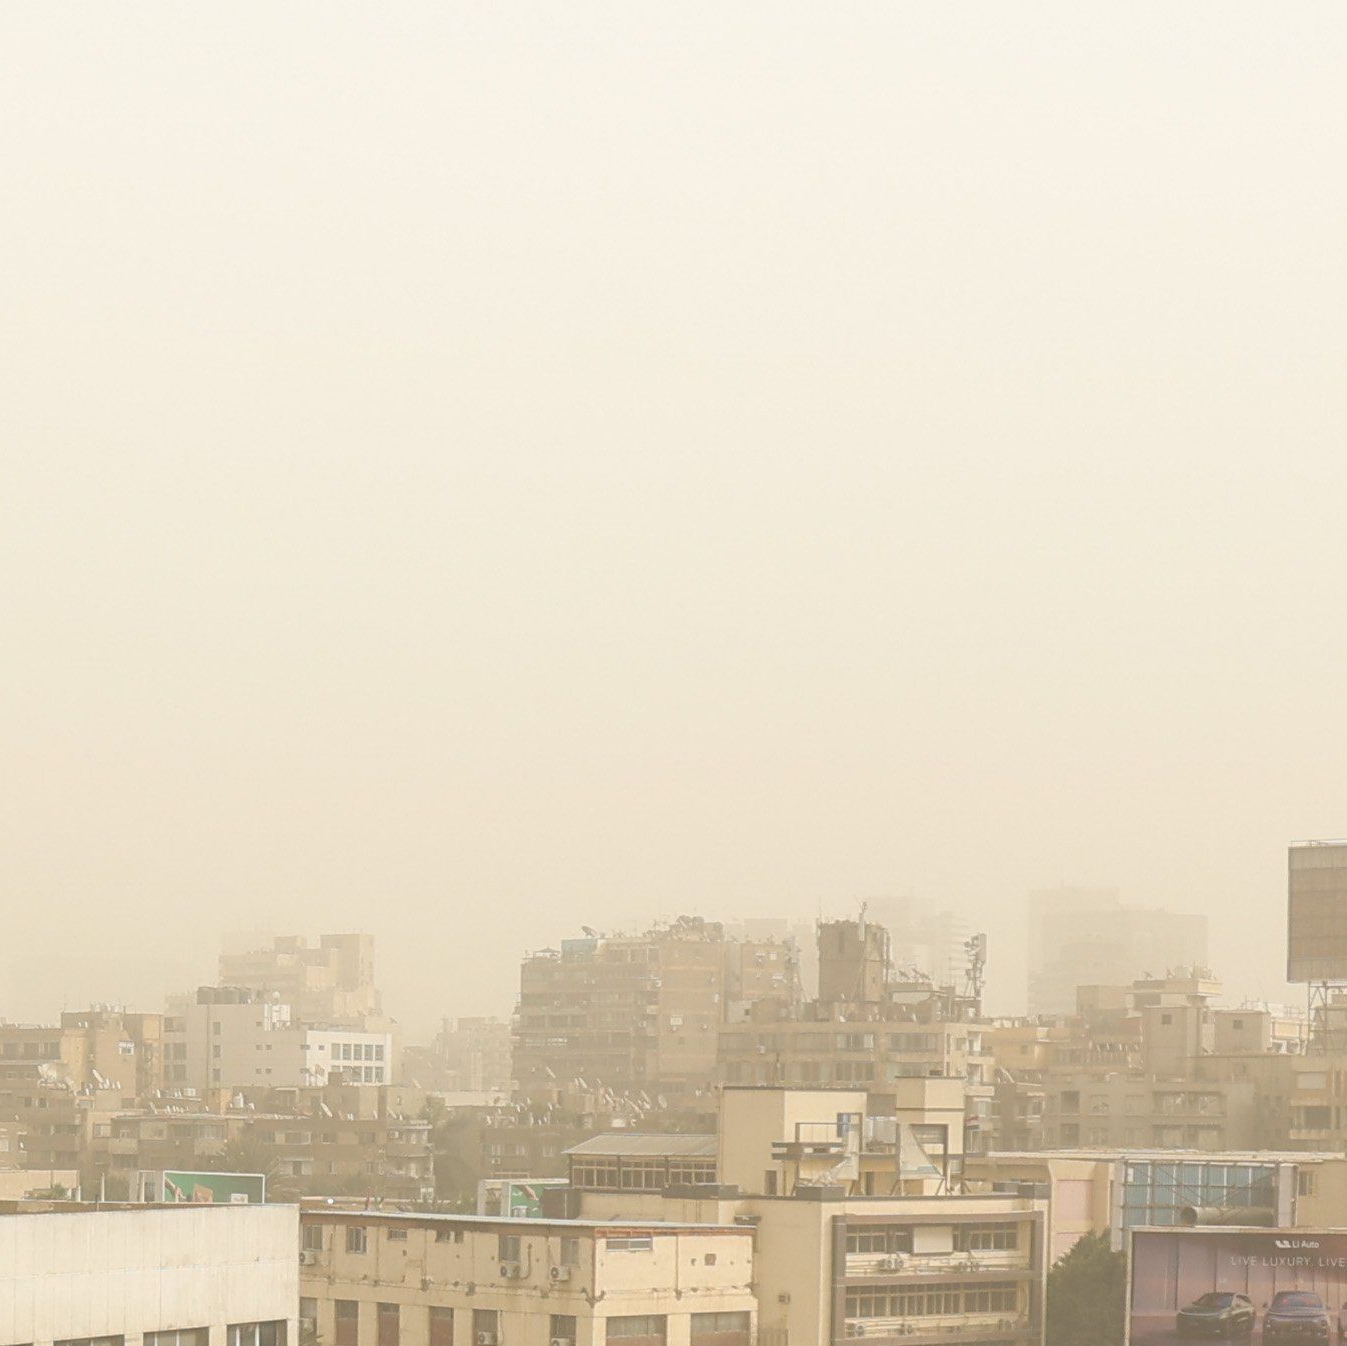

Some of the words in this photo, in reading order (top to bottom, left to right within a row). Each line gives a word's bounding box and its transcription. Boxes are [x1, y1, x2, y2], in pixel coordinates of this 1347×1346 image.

[1301, 1240, 1320, 1248] Auto
[1230, 1256, 1257, 1266] LIVE
[1319, 1257, 1347, 1267] LIVE
